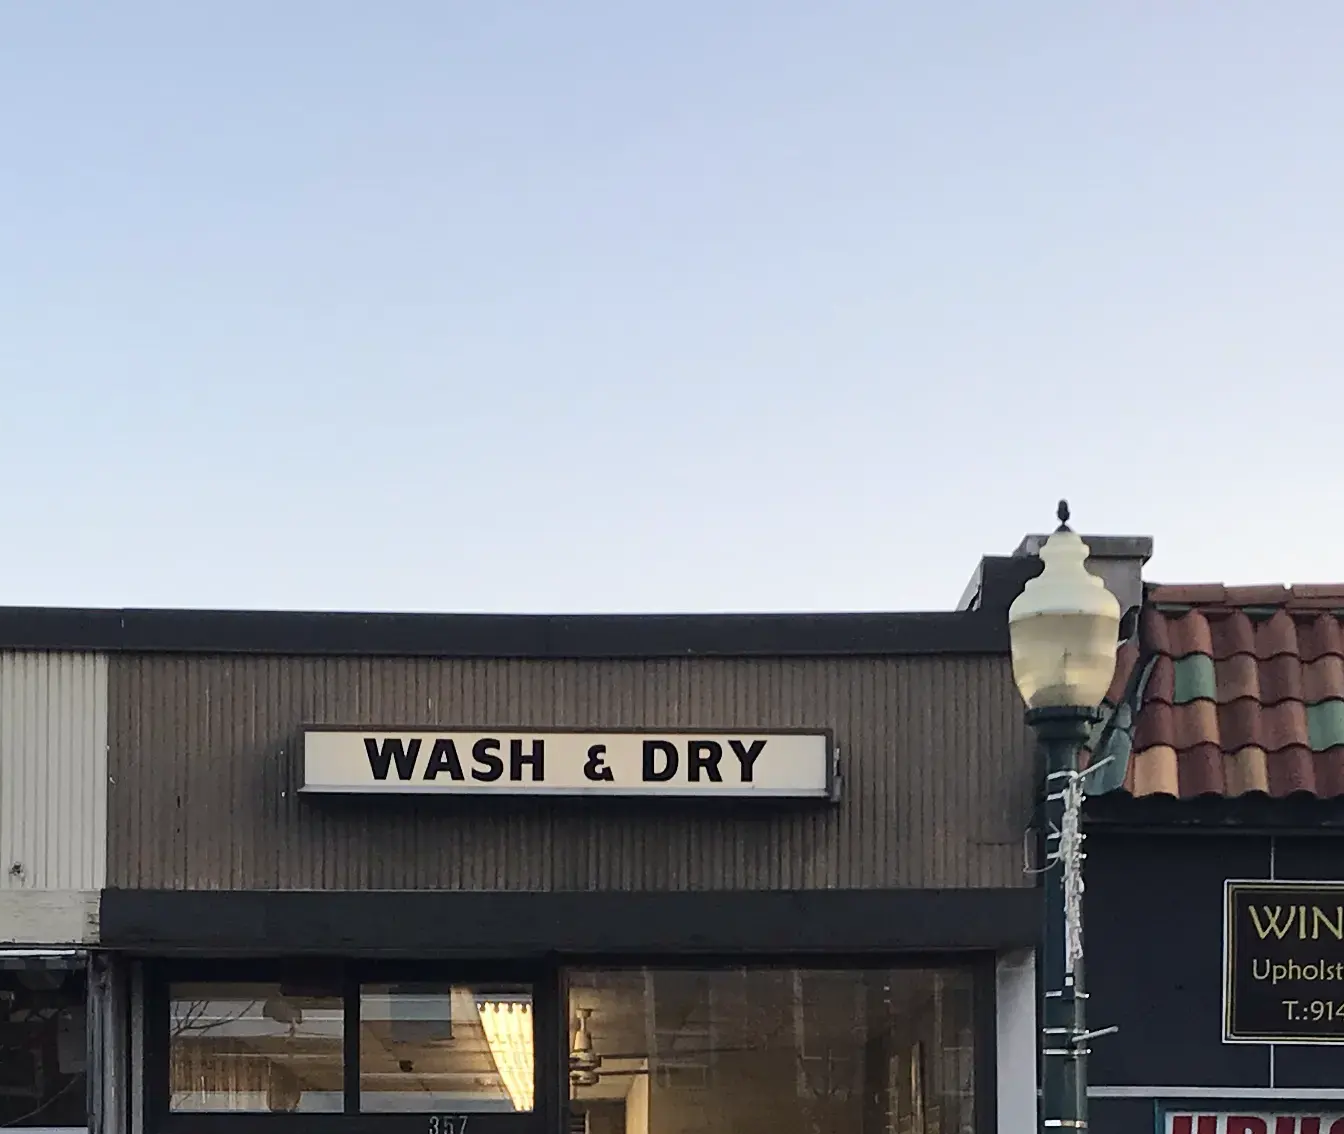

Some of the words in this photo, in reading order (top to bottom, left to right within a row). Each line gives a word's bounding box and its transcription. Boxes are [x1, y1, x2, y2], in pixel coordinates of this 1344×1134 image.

[363, 737, 545, 782] WASH
[583, 744, 614, 782] &
[641, 740, 768, 783] DRY
